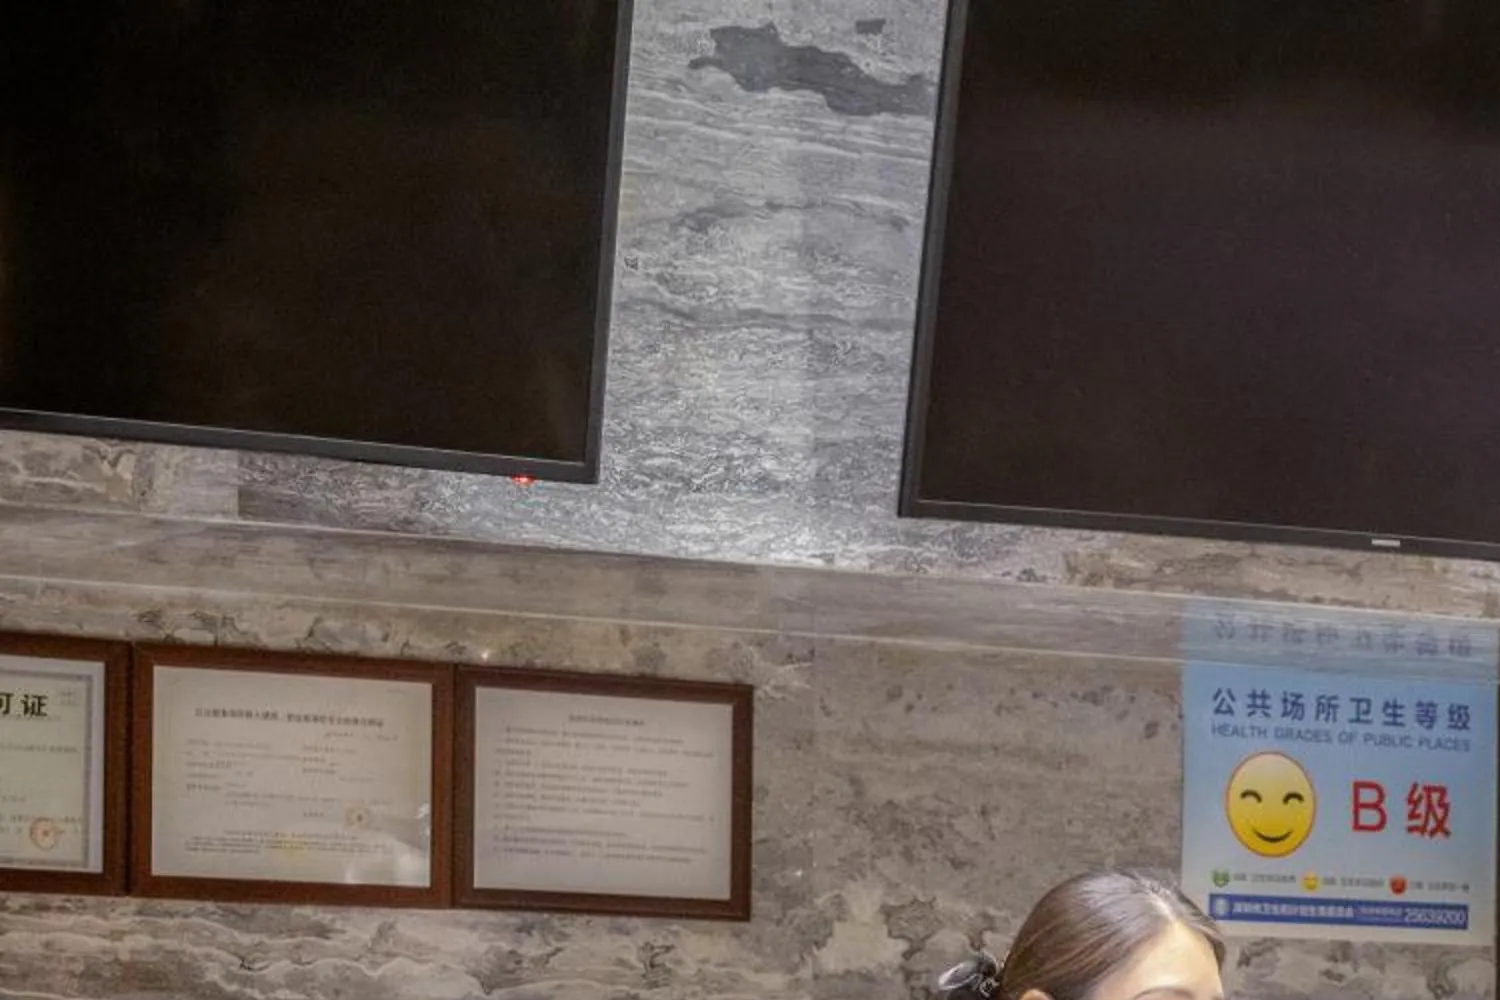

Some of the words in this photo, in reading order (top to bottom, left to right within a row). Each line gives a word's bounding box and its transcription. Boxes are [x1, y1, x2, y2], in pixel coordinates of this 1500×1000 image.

[1212, 687, 1472, 731] 公共场所卫生等级
[1211, 720, 1268, 739] HEALTH
[1274, 724, 1332, 744] GRADES
[1338, 730, 1358, 745] OF
[1363, 733, 1414, 749] PUBLIC
[1418, 737, 1472, 752] PLACES
